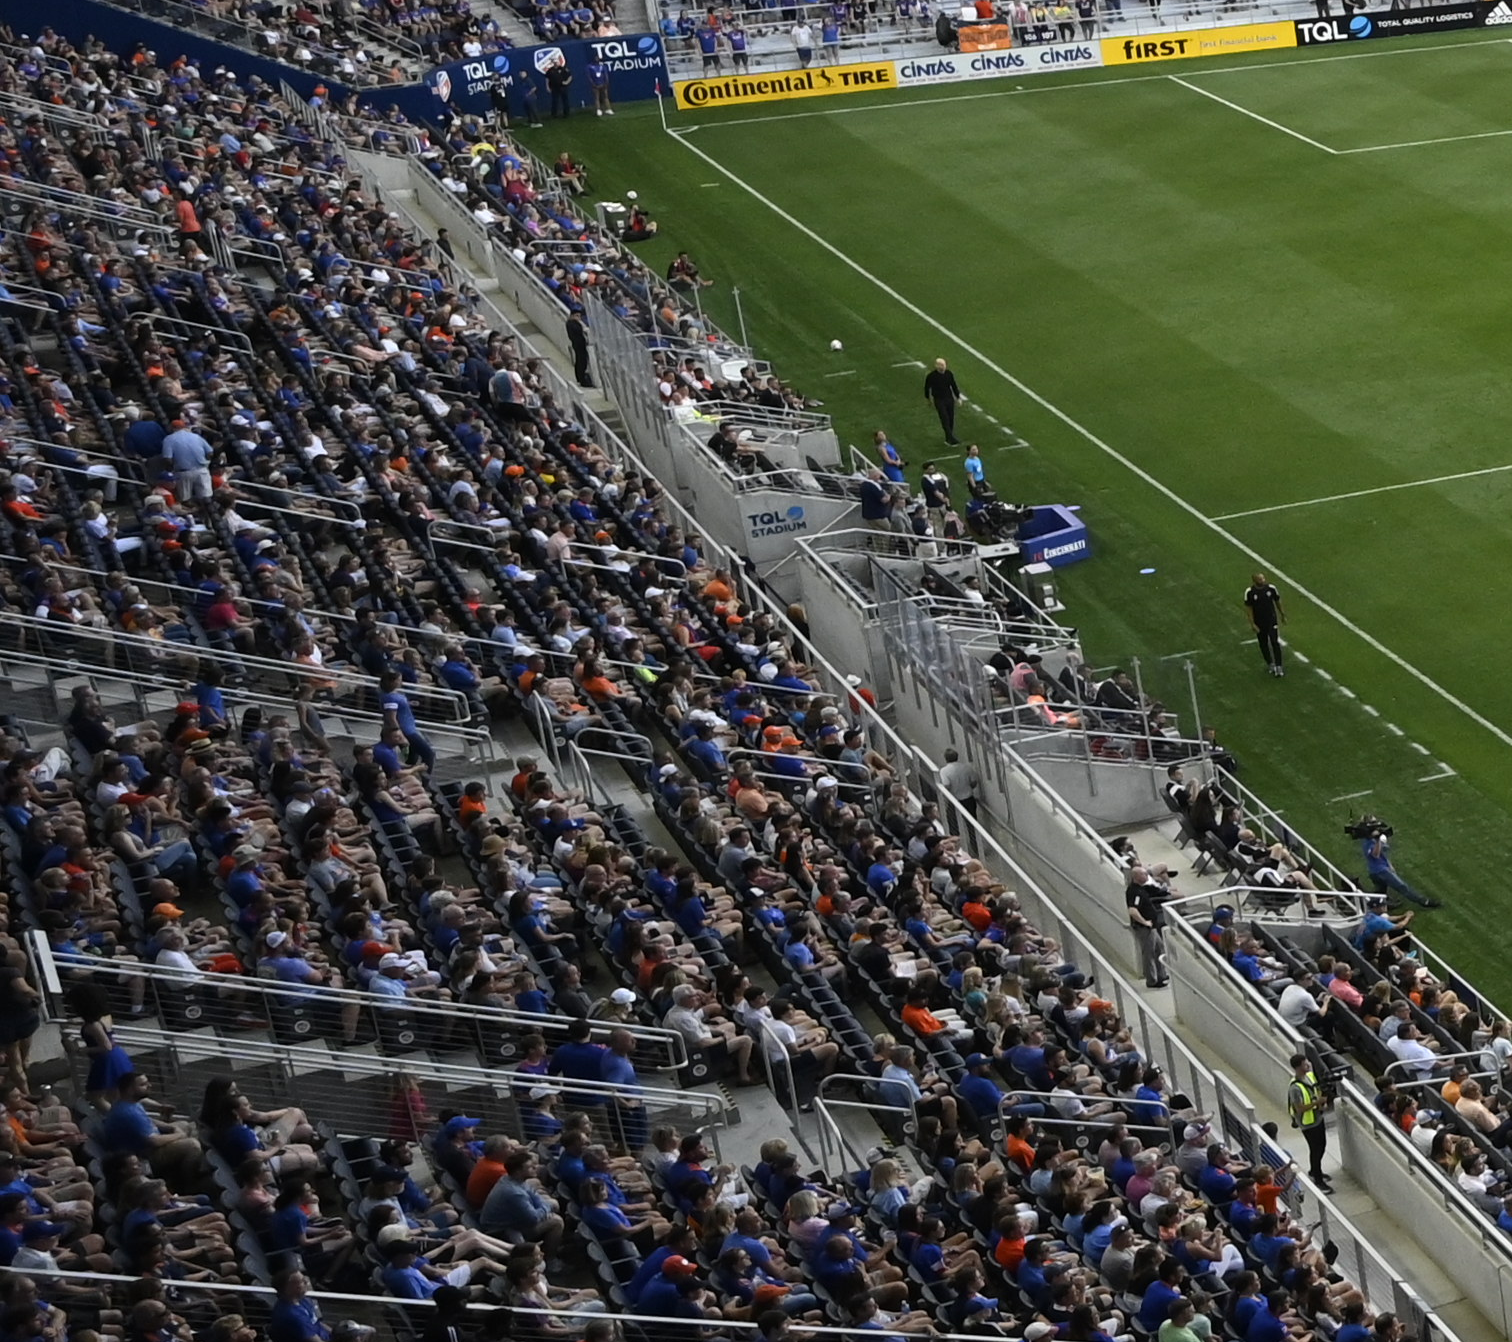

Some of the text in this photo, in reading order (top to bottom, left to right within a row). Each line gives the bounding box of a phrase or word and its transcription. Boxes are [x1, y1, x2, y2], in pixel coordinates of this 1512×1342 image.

[1298, 11, 1474, 44] TQL TOTAL QUALITY LOGISTICS
[591, 41, 637, 60] TQL
[463, 60, 493, 81] TQL
[683, 72, 813, 107] Continental
[838, 68, 890, 87] TIRE
[748, 511, 787, 527] TQL
[751, 520, 807, 538] STADIUM
[1043, 539, 1086, 560] CINCINNATI
